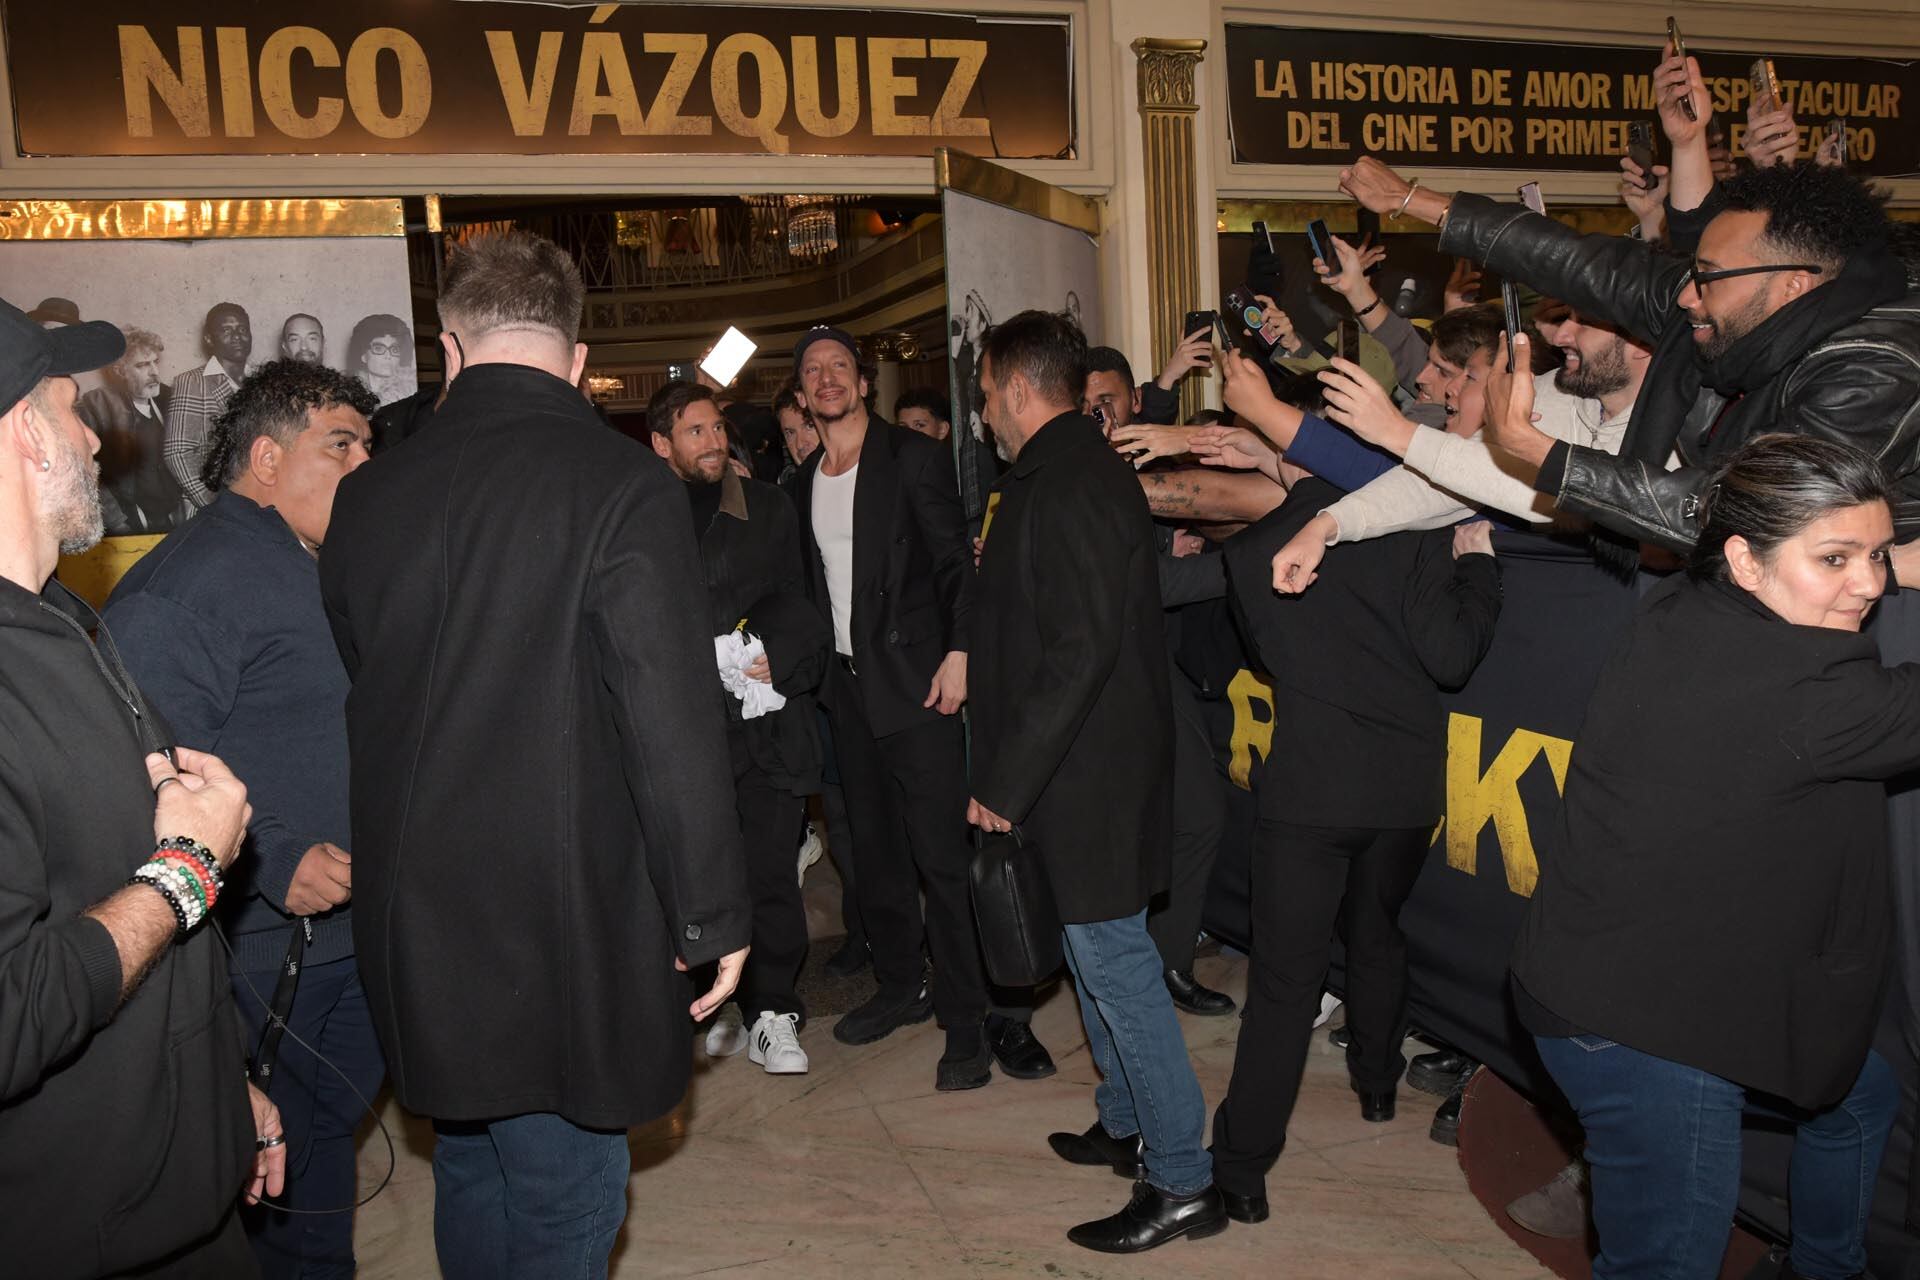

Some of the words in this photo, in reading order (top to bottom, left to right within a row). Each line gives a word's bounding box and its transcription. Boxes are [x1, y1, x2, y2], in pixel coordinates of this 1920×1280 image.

[118, 25, 432, 139] NICO
[485, 4, 990, 153] VÁZQUEZ
[1255, 59, 1298, 98] LA
[1311, 62, 1459, 105] HISTORIA
[1471, 68, 1512, 106] DE
[1523, 71, 1611, 109] AMOR
[1287, 111, 1350, 149] DEL
[1363, 113, 1438, 151] CINE
[1451, 116, 1514, 153] POR
